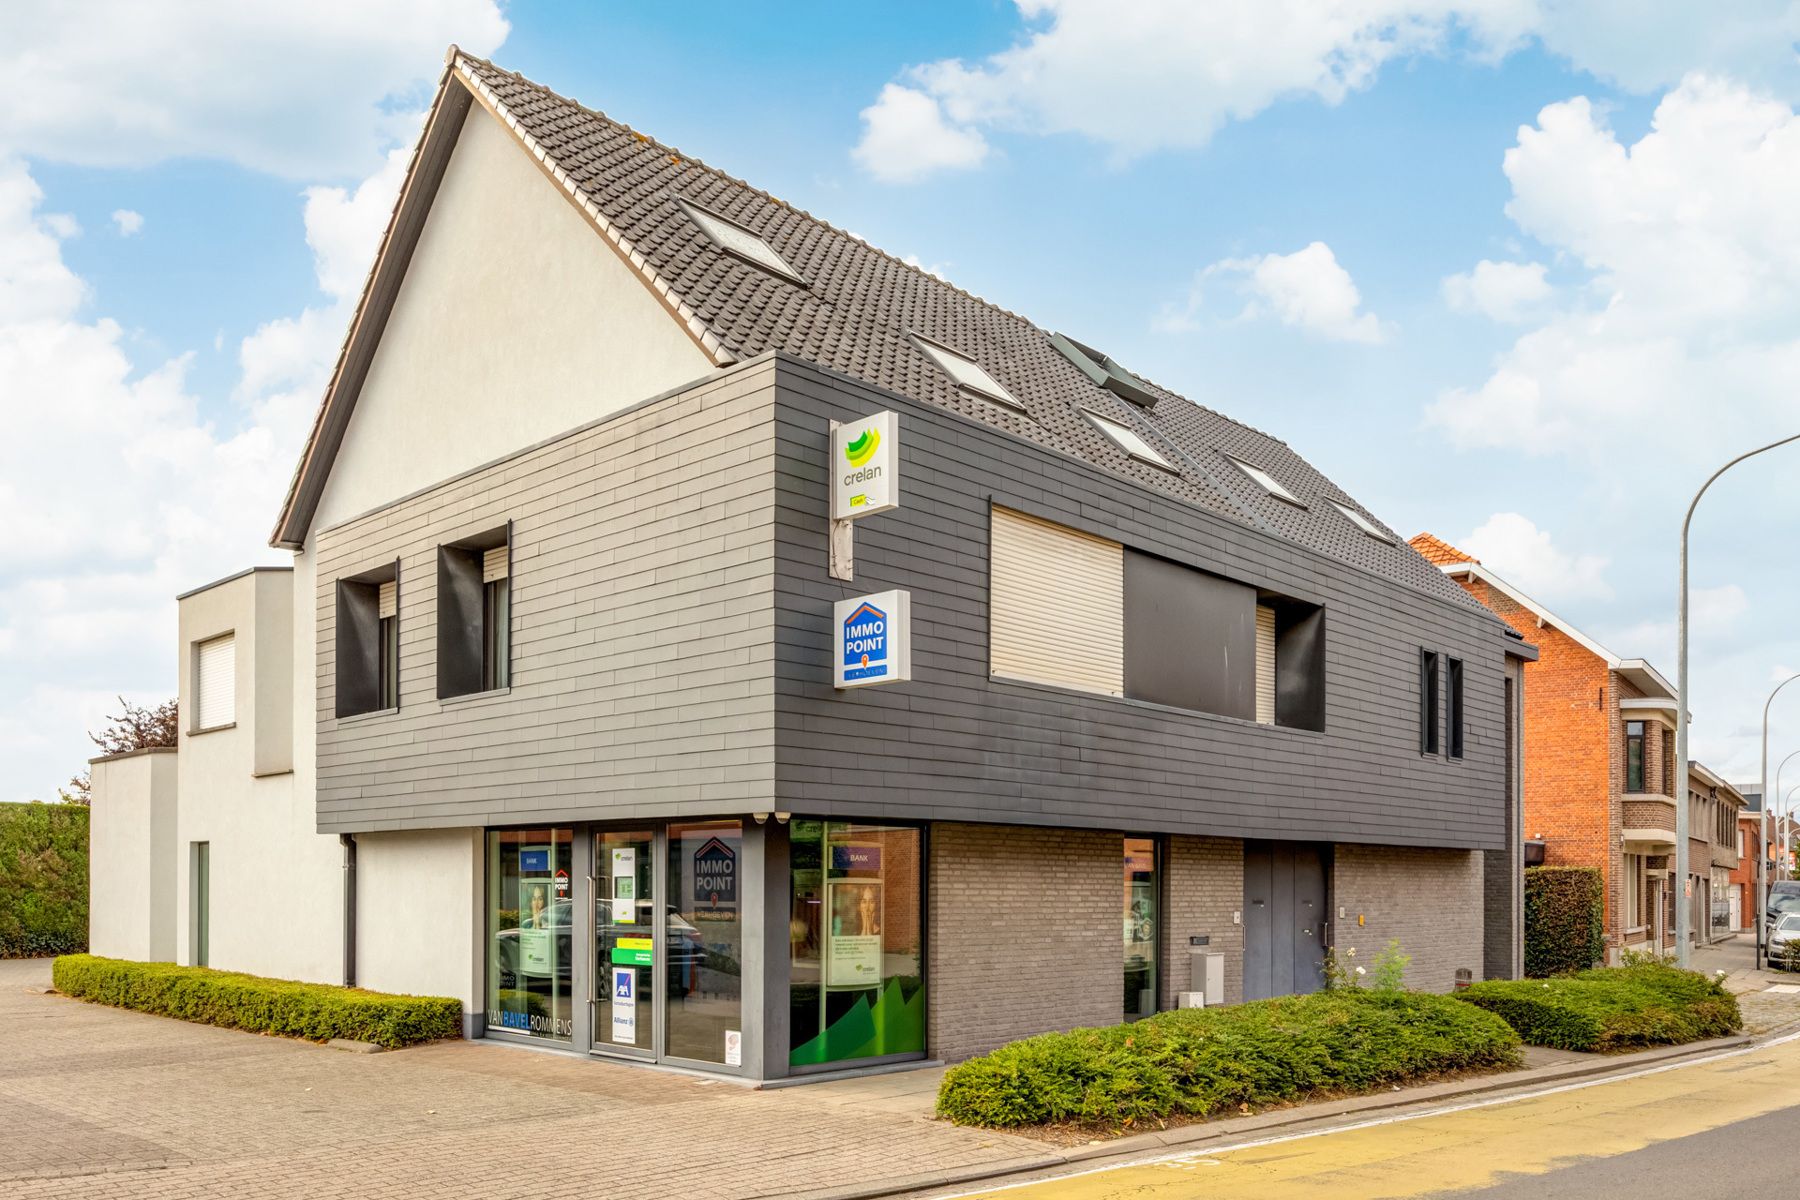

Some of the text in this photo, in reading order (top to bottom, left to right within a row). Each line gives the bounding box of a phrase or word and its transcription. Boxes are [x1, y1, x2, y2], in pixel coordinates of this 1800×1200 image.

[843, 466, 882, 487] crelan
[846, 620, 884, 640] IMMO
[846, 637, 884, 655] POINT
[850, 854, 868, 862] BANK
[696, 859, 733, 874] IMMO
[696, 876, 733, 891] POINT
[614, 1016, 628, 1025] Allianz
